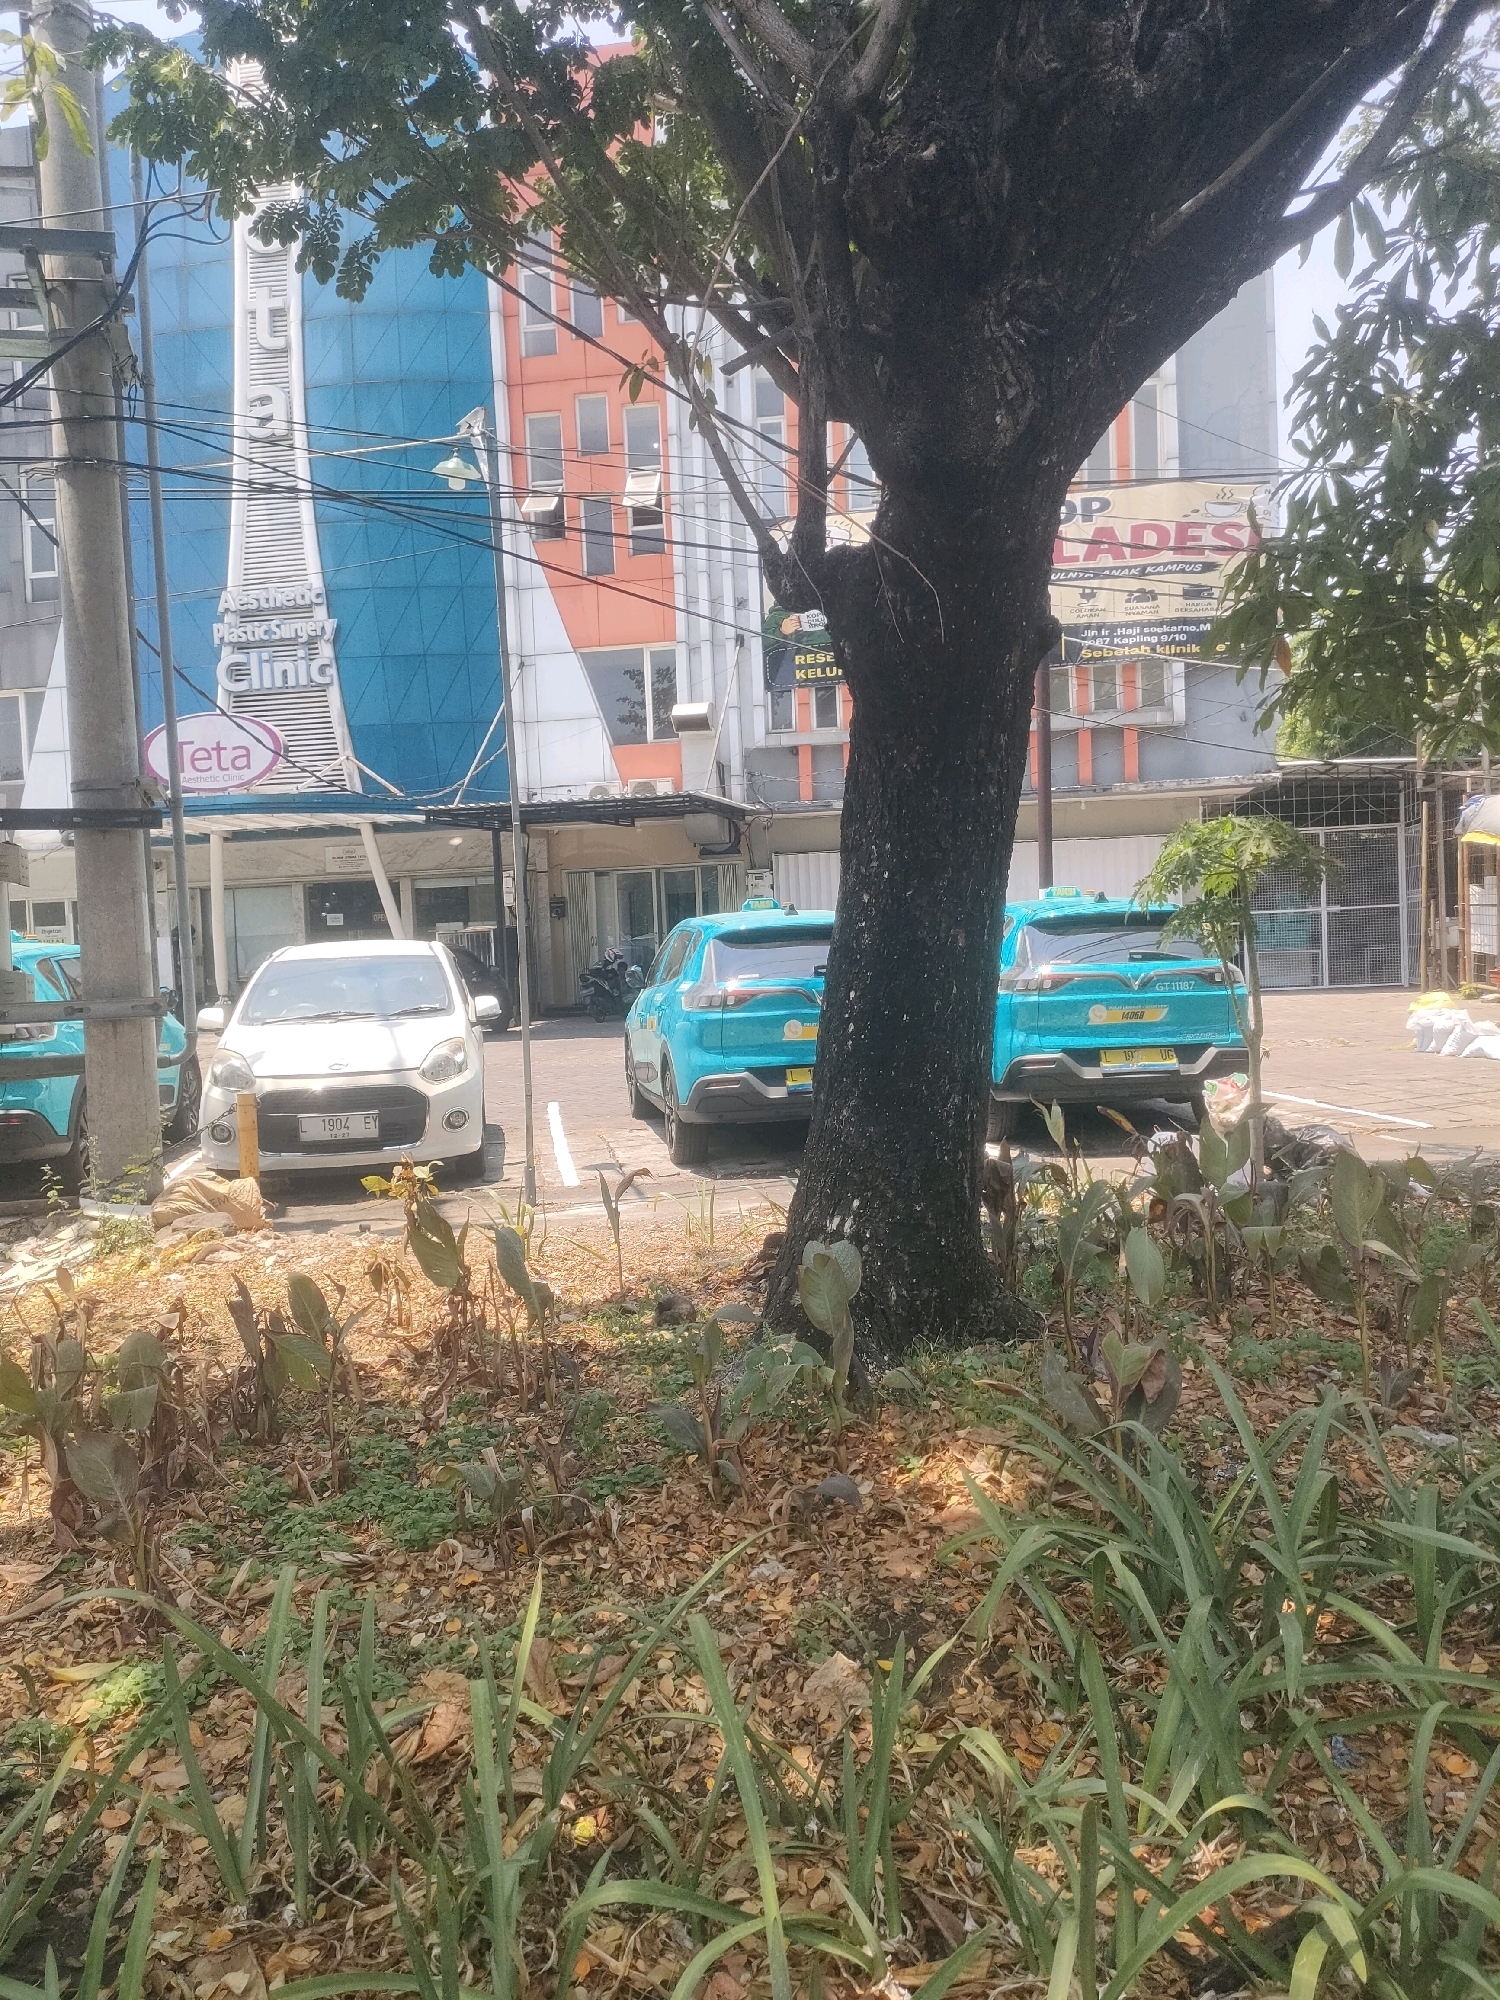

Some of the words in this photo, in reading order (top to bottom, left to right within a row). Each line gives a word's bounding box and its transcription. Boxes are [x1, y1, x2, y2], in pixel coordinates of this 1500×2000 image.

[1053, 522, 1260, 564] LADES
[1103, 567, 1141, 577] ANAK
[1145, 563, 1203, 574] KAMPUS
[217, 583, 326, 615] Aesthetic
[213, 622, 270, 647] Plastic
[270, 618, 338, 643] Surgery
[1102, 628, 1110, 636] ir
[1143, 623, 1211, 633] soekarno,M
[1114, 634, 1158, 645] Kapling
[1161, 633, 1187, 643] 9/10
[1081, 645, 1151, 658] Sebelah
[1156, 644, 1202, 655] klinik
[795, 652, 836, 665] RESE
[216, 649, 334, 692] Clinic
[177, 739, 252, 774] Teta
[181, 774, 221, 784] Aesthetic
[222, 773, 245, 782] Clinic
[1052, 887, 1076, 896] TAKSI
[749, 900, 773, 909] TAKSI
[1104, 1050, 1111, 1062] L
[1159, 1049, 1174, 1060] UG
[300, 1119, 307, 1133] L
[321, 1116, 350, 1131] 1904
[363, 1115, 378, 1130] EY
